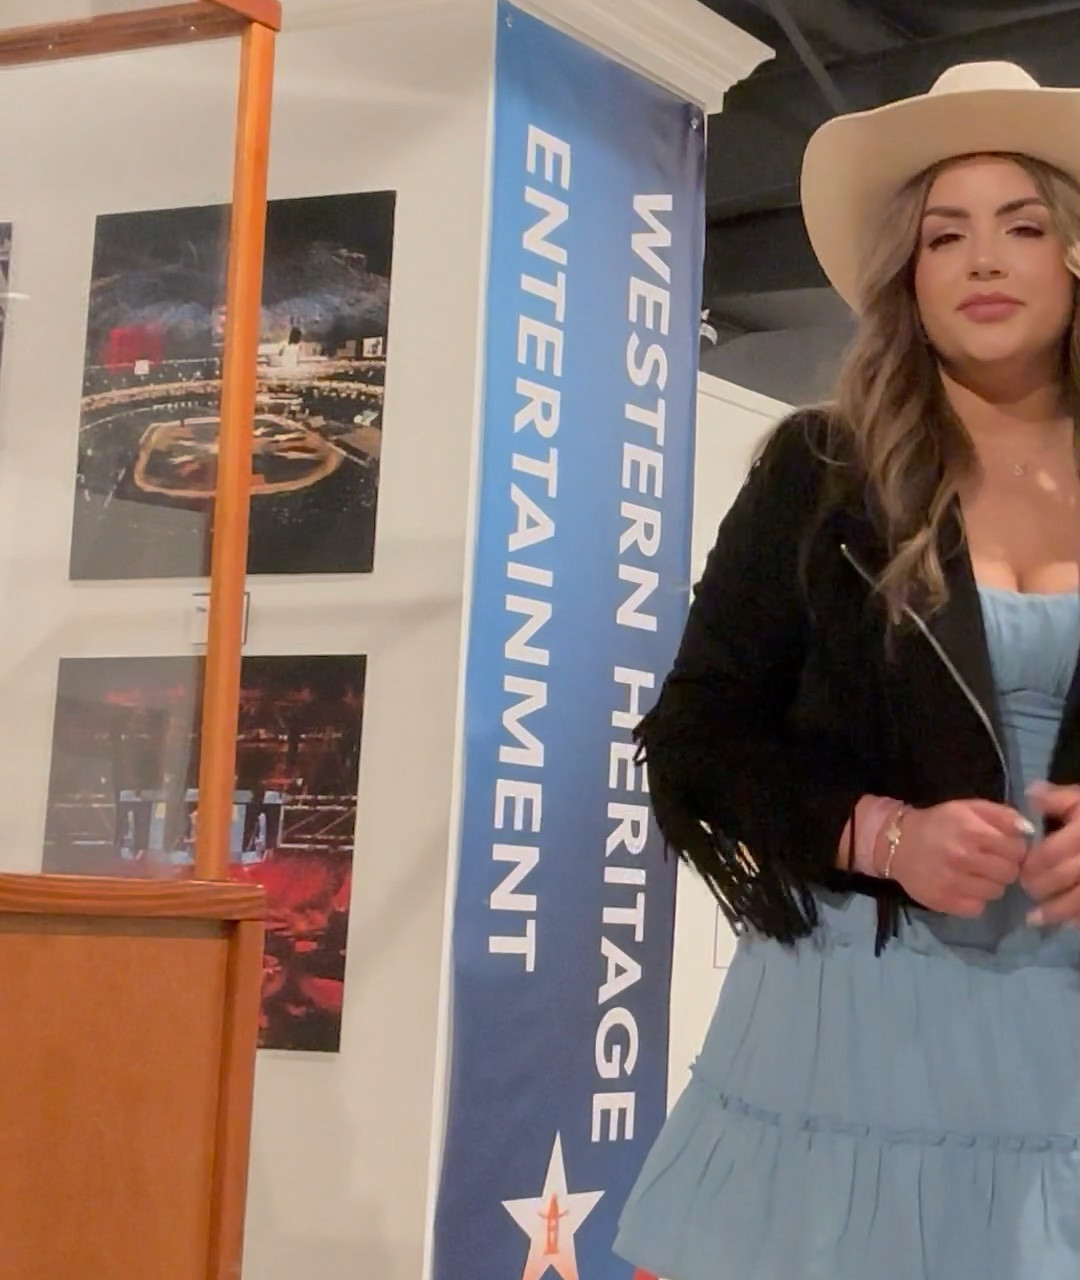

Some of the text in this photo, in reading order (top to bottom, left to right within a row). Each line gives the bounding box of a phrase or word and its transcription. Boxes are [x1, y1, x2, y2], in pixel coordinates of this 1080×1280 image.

[489, 124, 572, 972] ENTERTAINMENT
[591, 193, 673, 1142] WESTERN HERITAGE
